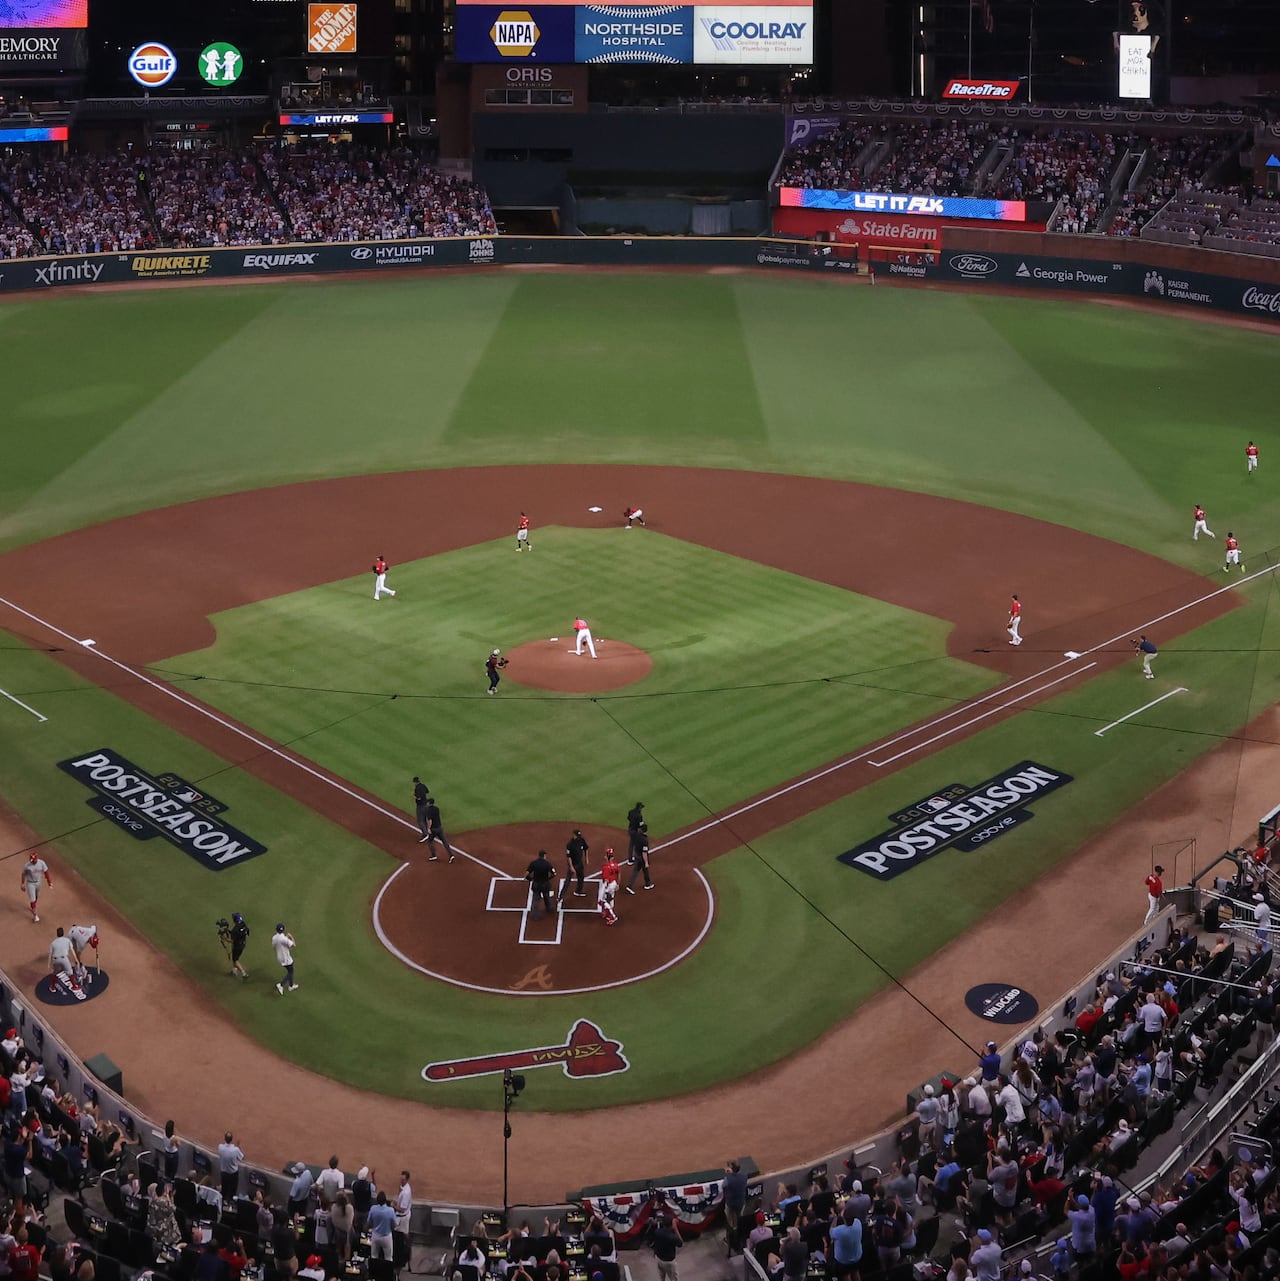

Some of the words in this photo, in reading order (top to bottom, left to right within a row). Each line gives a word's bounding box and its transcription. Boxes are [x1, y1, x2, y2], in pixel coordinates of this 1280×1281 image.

[313, 9, 334, 28] THE
[309, 4, 356, 51] HOME
[498, 22, 532, 44] NAPA
[585, 24, 683, 35] NORTHSIDE
[710, 23, 807, 39] COOLRAY
[326, 21, 356, 51] DEPOT
[603, 37, 665, 46] HOSPITAL
[736, 39, 758, 47] Cooling
[0, 37, 60, 53] EMORY
[132, 58, 173, 71] Gulf
[506, 67, 553, 82] ORIS
[949, 83, 1011, 96] RaceTrac
[855, 195, 887, 208] LET
[890, 196, 907, 210] IT
[376, 246, 435, 257] HYUNDAI
[470, 240, 494, 249] PAPA
[469, 248, 495, 257] JOHNS
[131, 256, 210, 271] QUIKRETE
[243, 253, 316, 269] EQUIFAX
[958, 256, 989, 272] Ford
[35, 261, 105, 285] xfinity
[1033, 268, 1073, 282] Georgia
[1076, 270, 1108, 283] Power
[1168, 280, 1189, 289] KAISER
[1168, 289, 1210, 303] PERMANENTE
[160, 776, 181, 788] 20
[71, 753, 252, 864] POSTSEASON
[897, 810, 921, 822] 20
[102, 804, 144, 831] abbvie
[853, 766, 1060, 874] POSTSEASON
[971, 816, 1017, 843] abbvie
